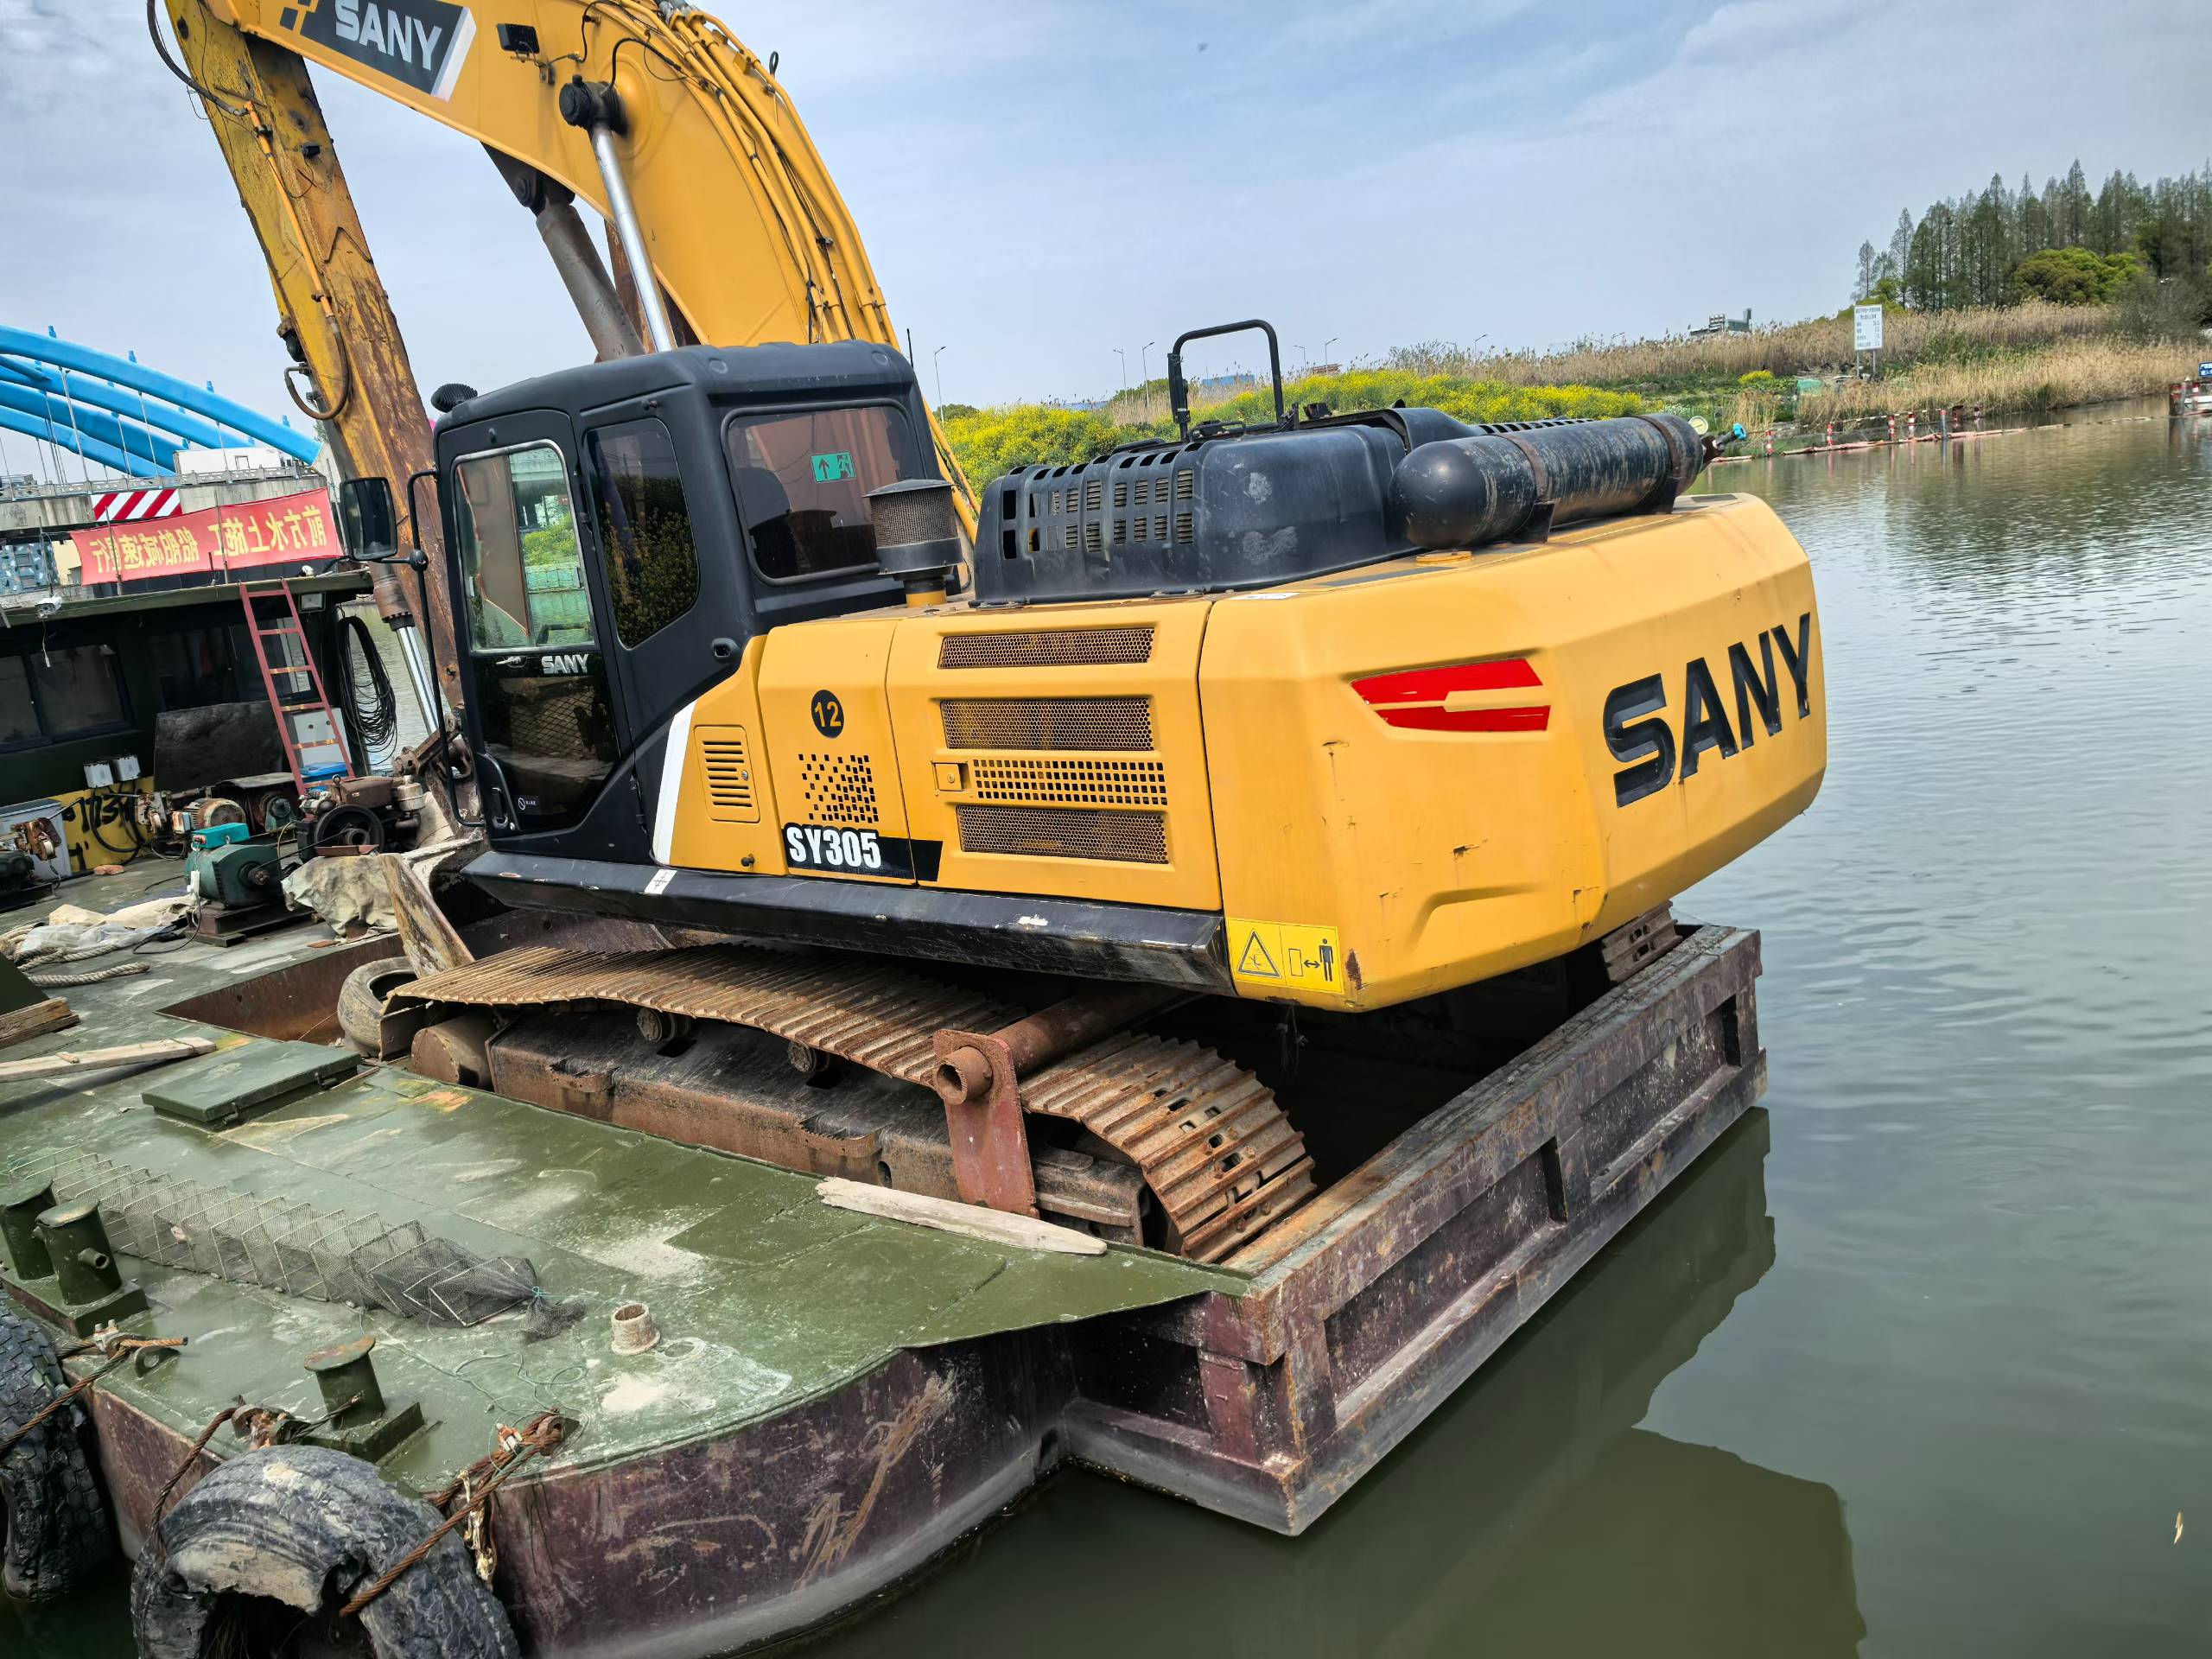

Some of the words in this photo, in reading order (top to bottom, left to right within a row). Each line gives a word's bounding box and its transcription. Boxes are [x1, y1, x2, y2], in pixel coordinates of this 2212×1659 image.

[335, 0, 442, 71] SANY
[541, 653, 589, 674] SANY
[815, 701, 842, 727] 12
[1603, 612, 1810, 809] SANY
[786, 826, 881, 868] SY305
